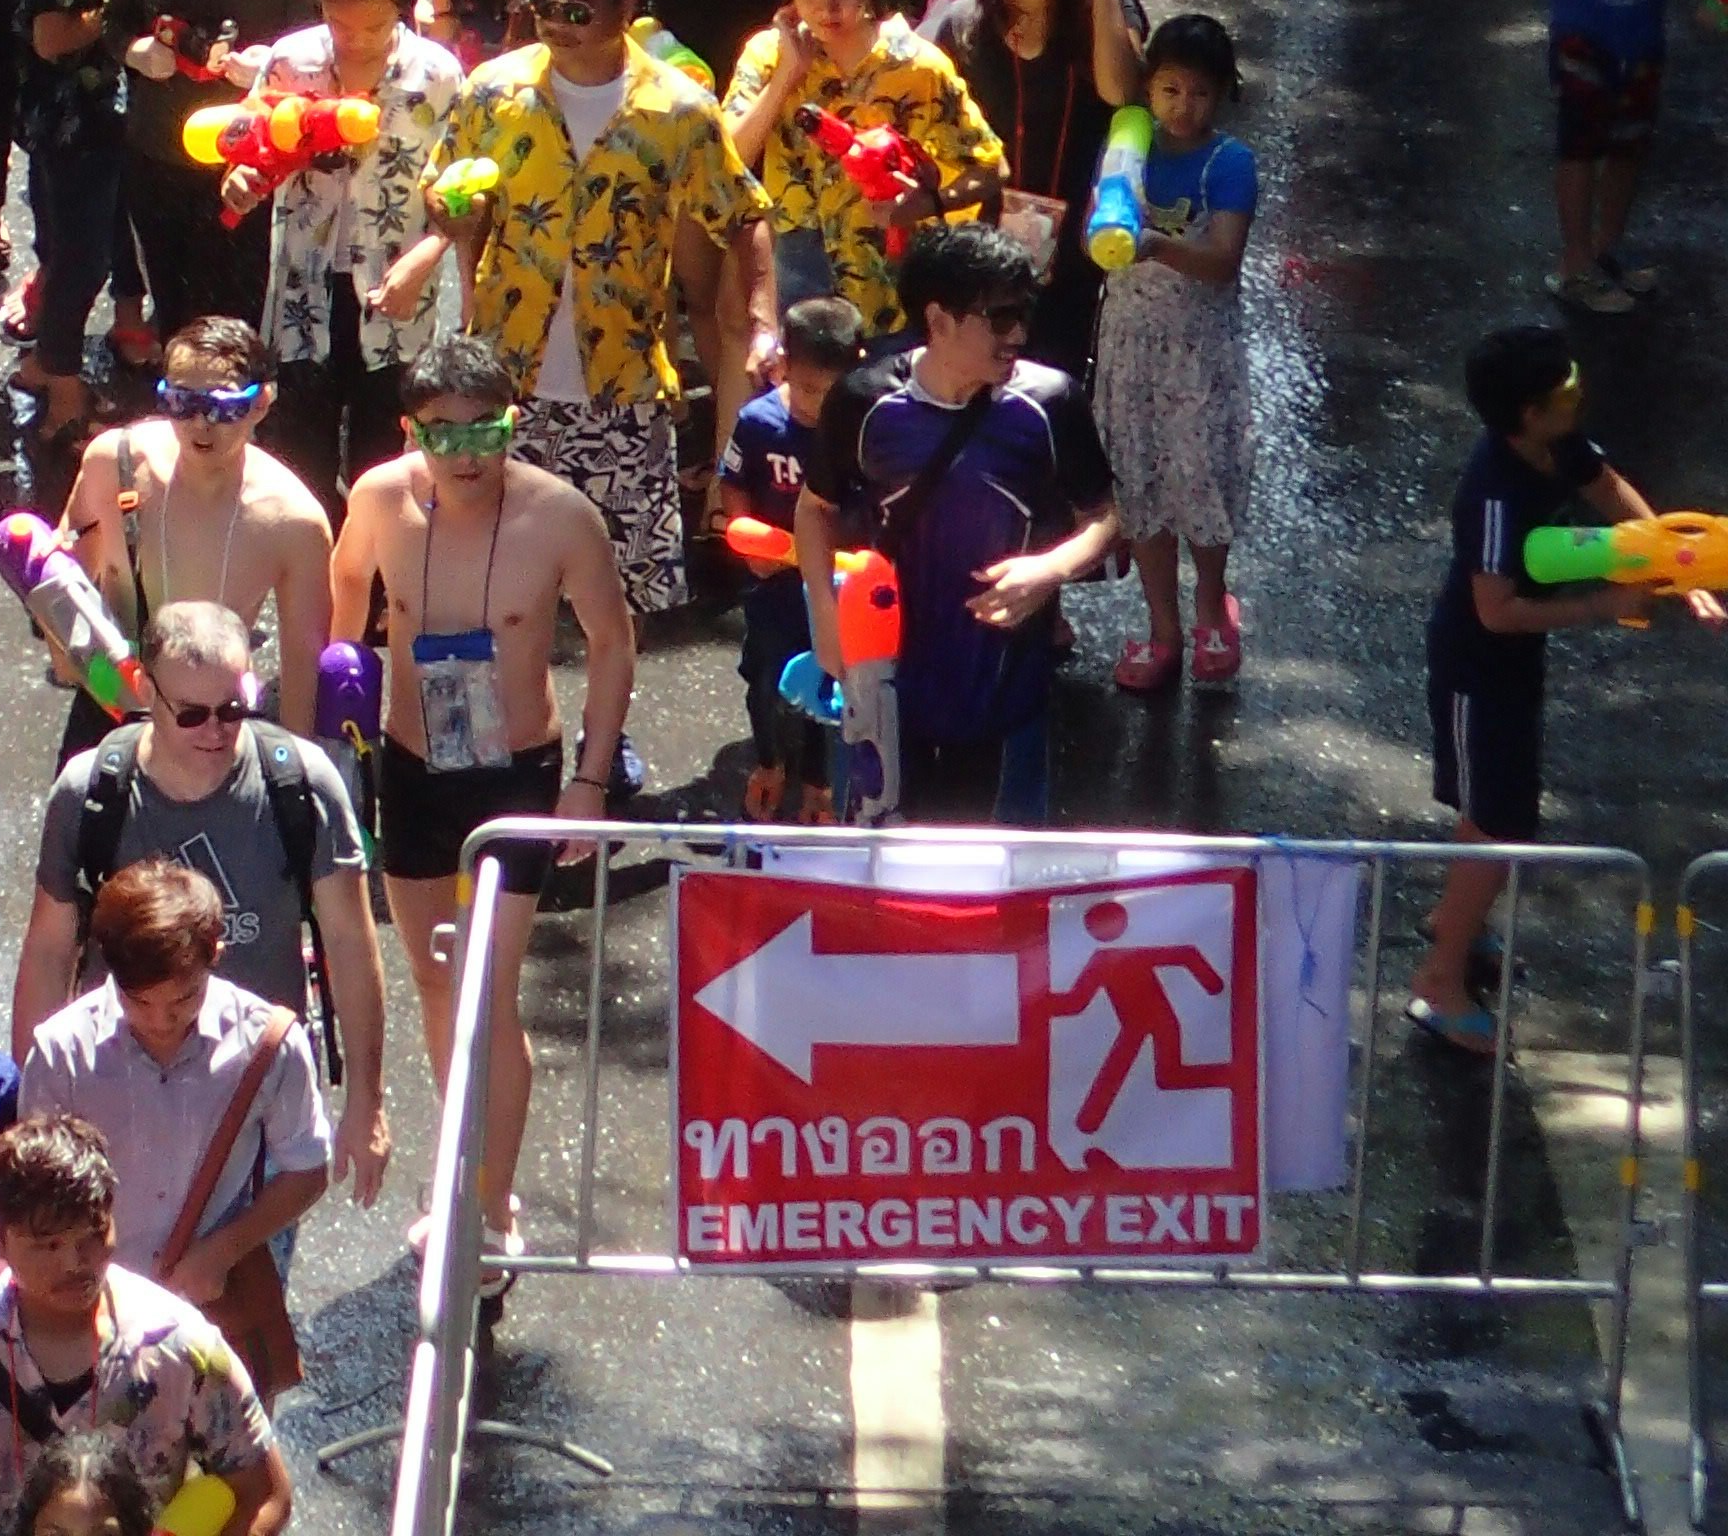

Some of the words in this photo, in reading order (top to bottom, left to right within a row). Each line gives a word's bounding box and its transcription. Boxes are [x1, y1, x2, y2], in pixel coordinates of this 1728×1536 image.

[684, 1114, 1036, 1179] ทางออก
[687, 1195, 1101, 1253] EMERGENCY
[1109, 1193, 1255, 1244] EXIT
